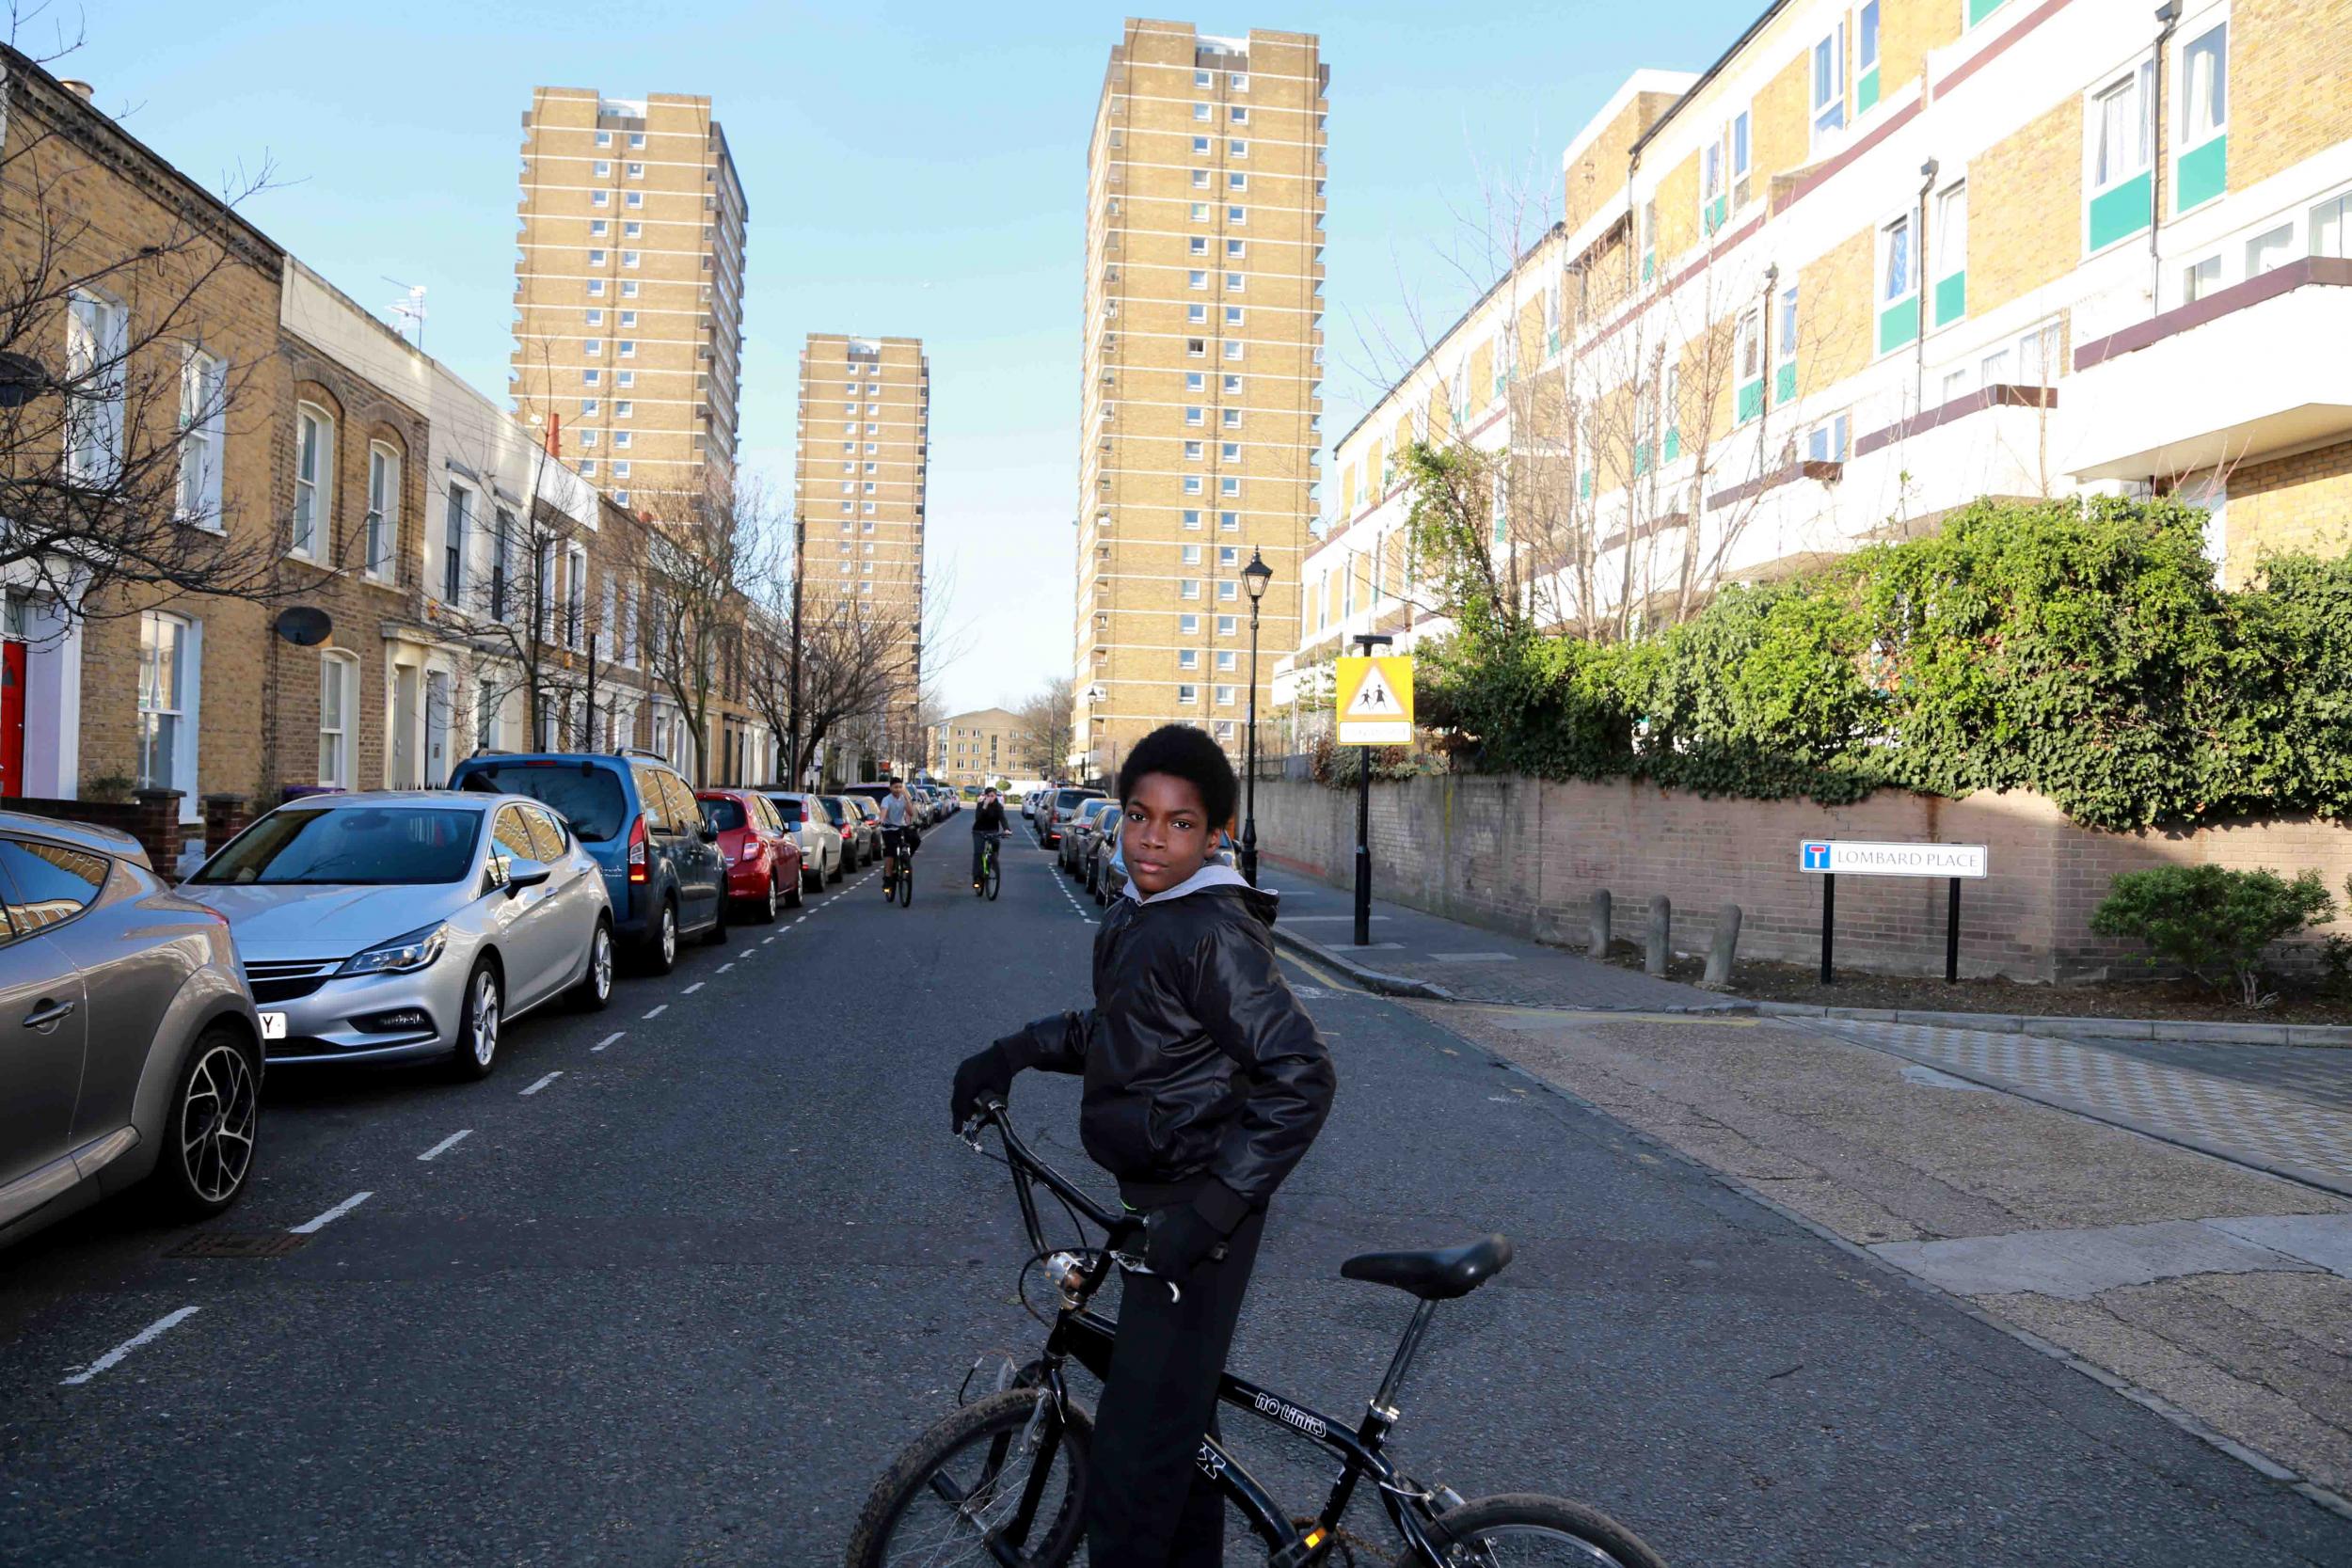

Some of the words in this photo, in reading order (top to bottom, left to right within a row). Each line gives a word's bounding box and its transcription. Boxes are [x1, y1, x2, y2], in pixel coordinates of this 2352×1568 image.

[1837, 849, 1922, 866] LOMBARD
[1927, 853, 1978, 868] PLACE
[1196, 1441, 1227, 1481] X
